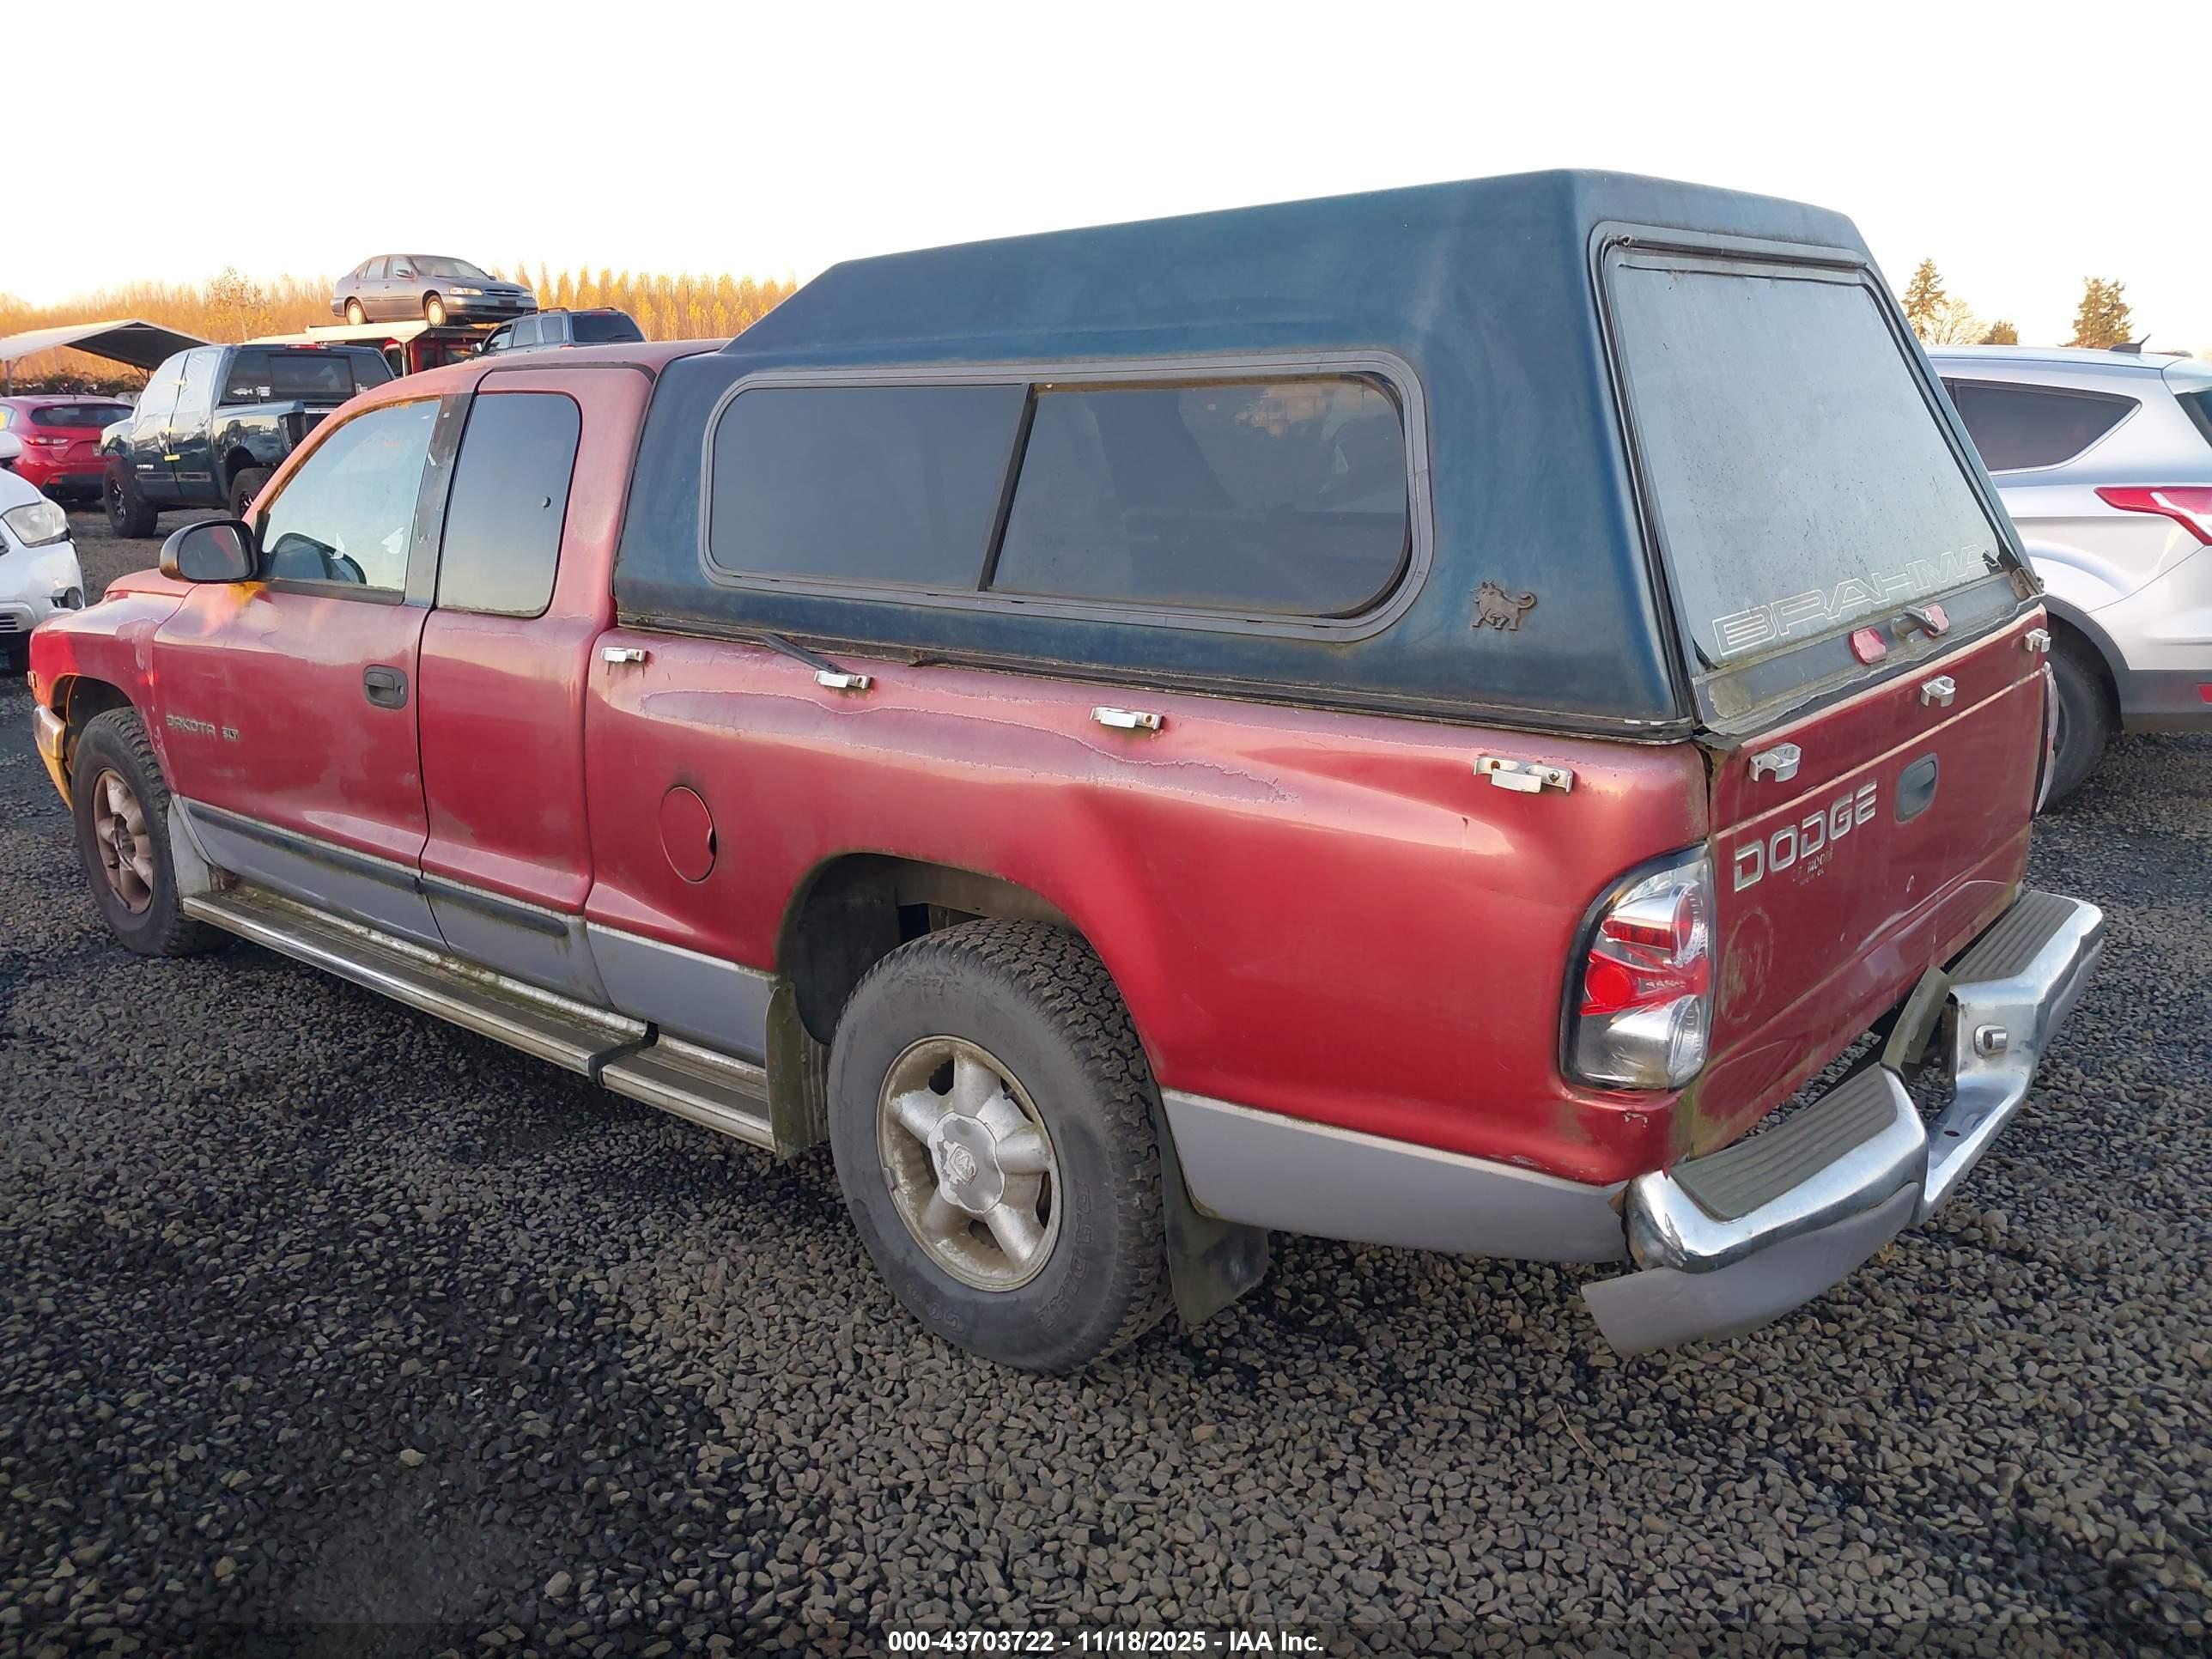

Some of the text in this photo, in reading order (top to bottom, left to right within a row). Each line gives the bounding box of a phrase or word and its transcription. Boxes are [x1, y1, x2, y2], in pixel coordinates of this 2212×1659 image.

[1711, 544, 2003, 657] BRAHMA
[166, 714, 216, 736] DAKOTA
[1734, 780, 1878, 893] DODGE
